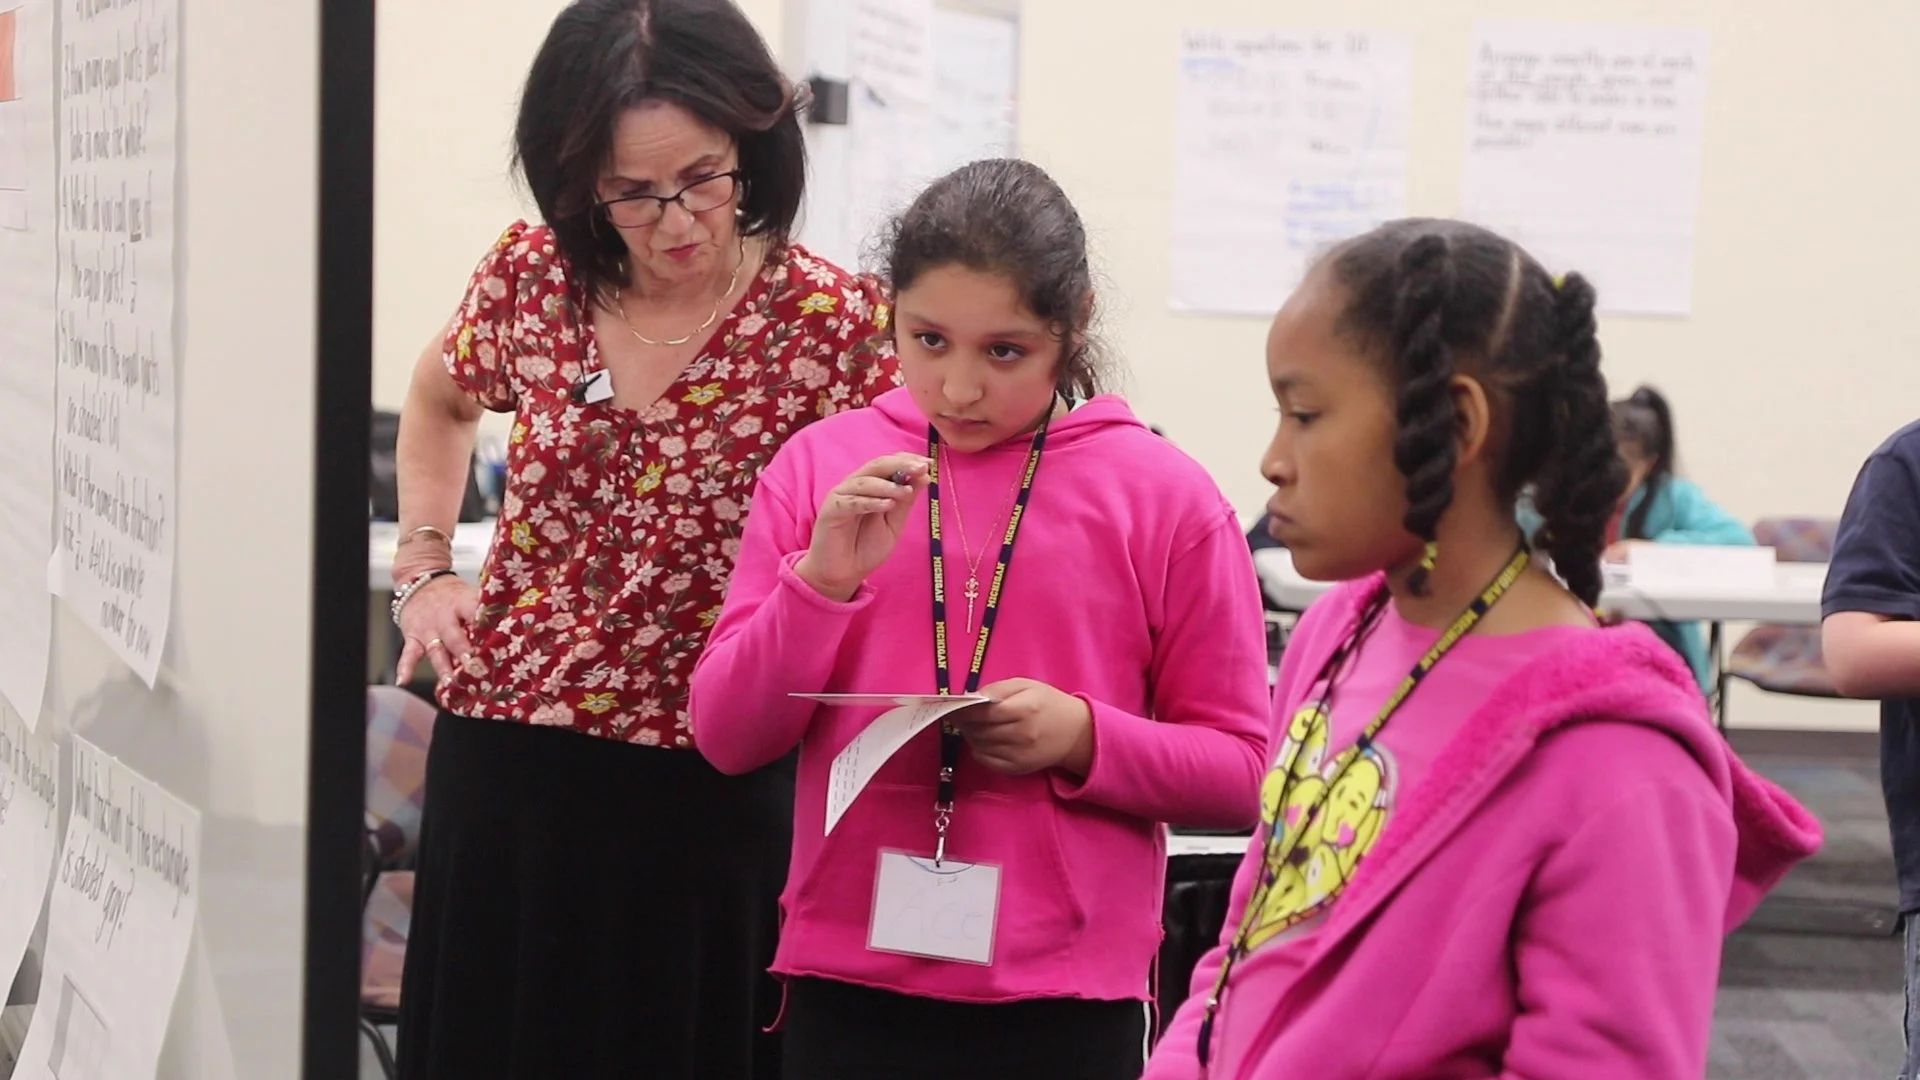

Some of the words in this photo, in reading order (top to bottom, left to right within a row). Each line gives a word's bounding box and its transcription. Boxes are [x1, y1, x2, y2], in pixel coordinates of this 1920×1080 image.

[1022, 450, 1040, 489] MICHIGAN
[931, 499, 941, 540] MICHIGAN
[1003, 504, 1023, 545] MICHIGAN
[933, 556, 944, 603] MICHIGAN
[987, 562, 1006, 608] MICHIGAN
[936, 621, 947, 669] MICHIGAN
[970, 626, 990, 673] MICHIGAN
